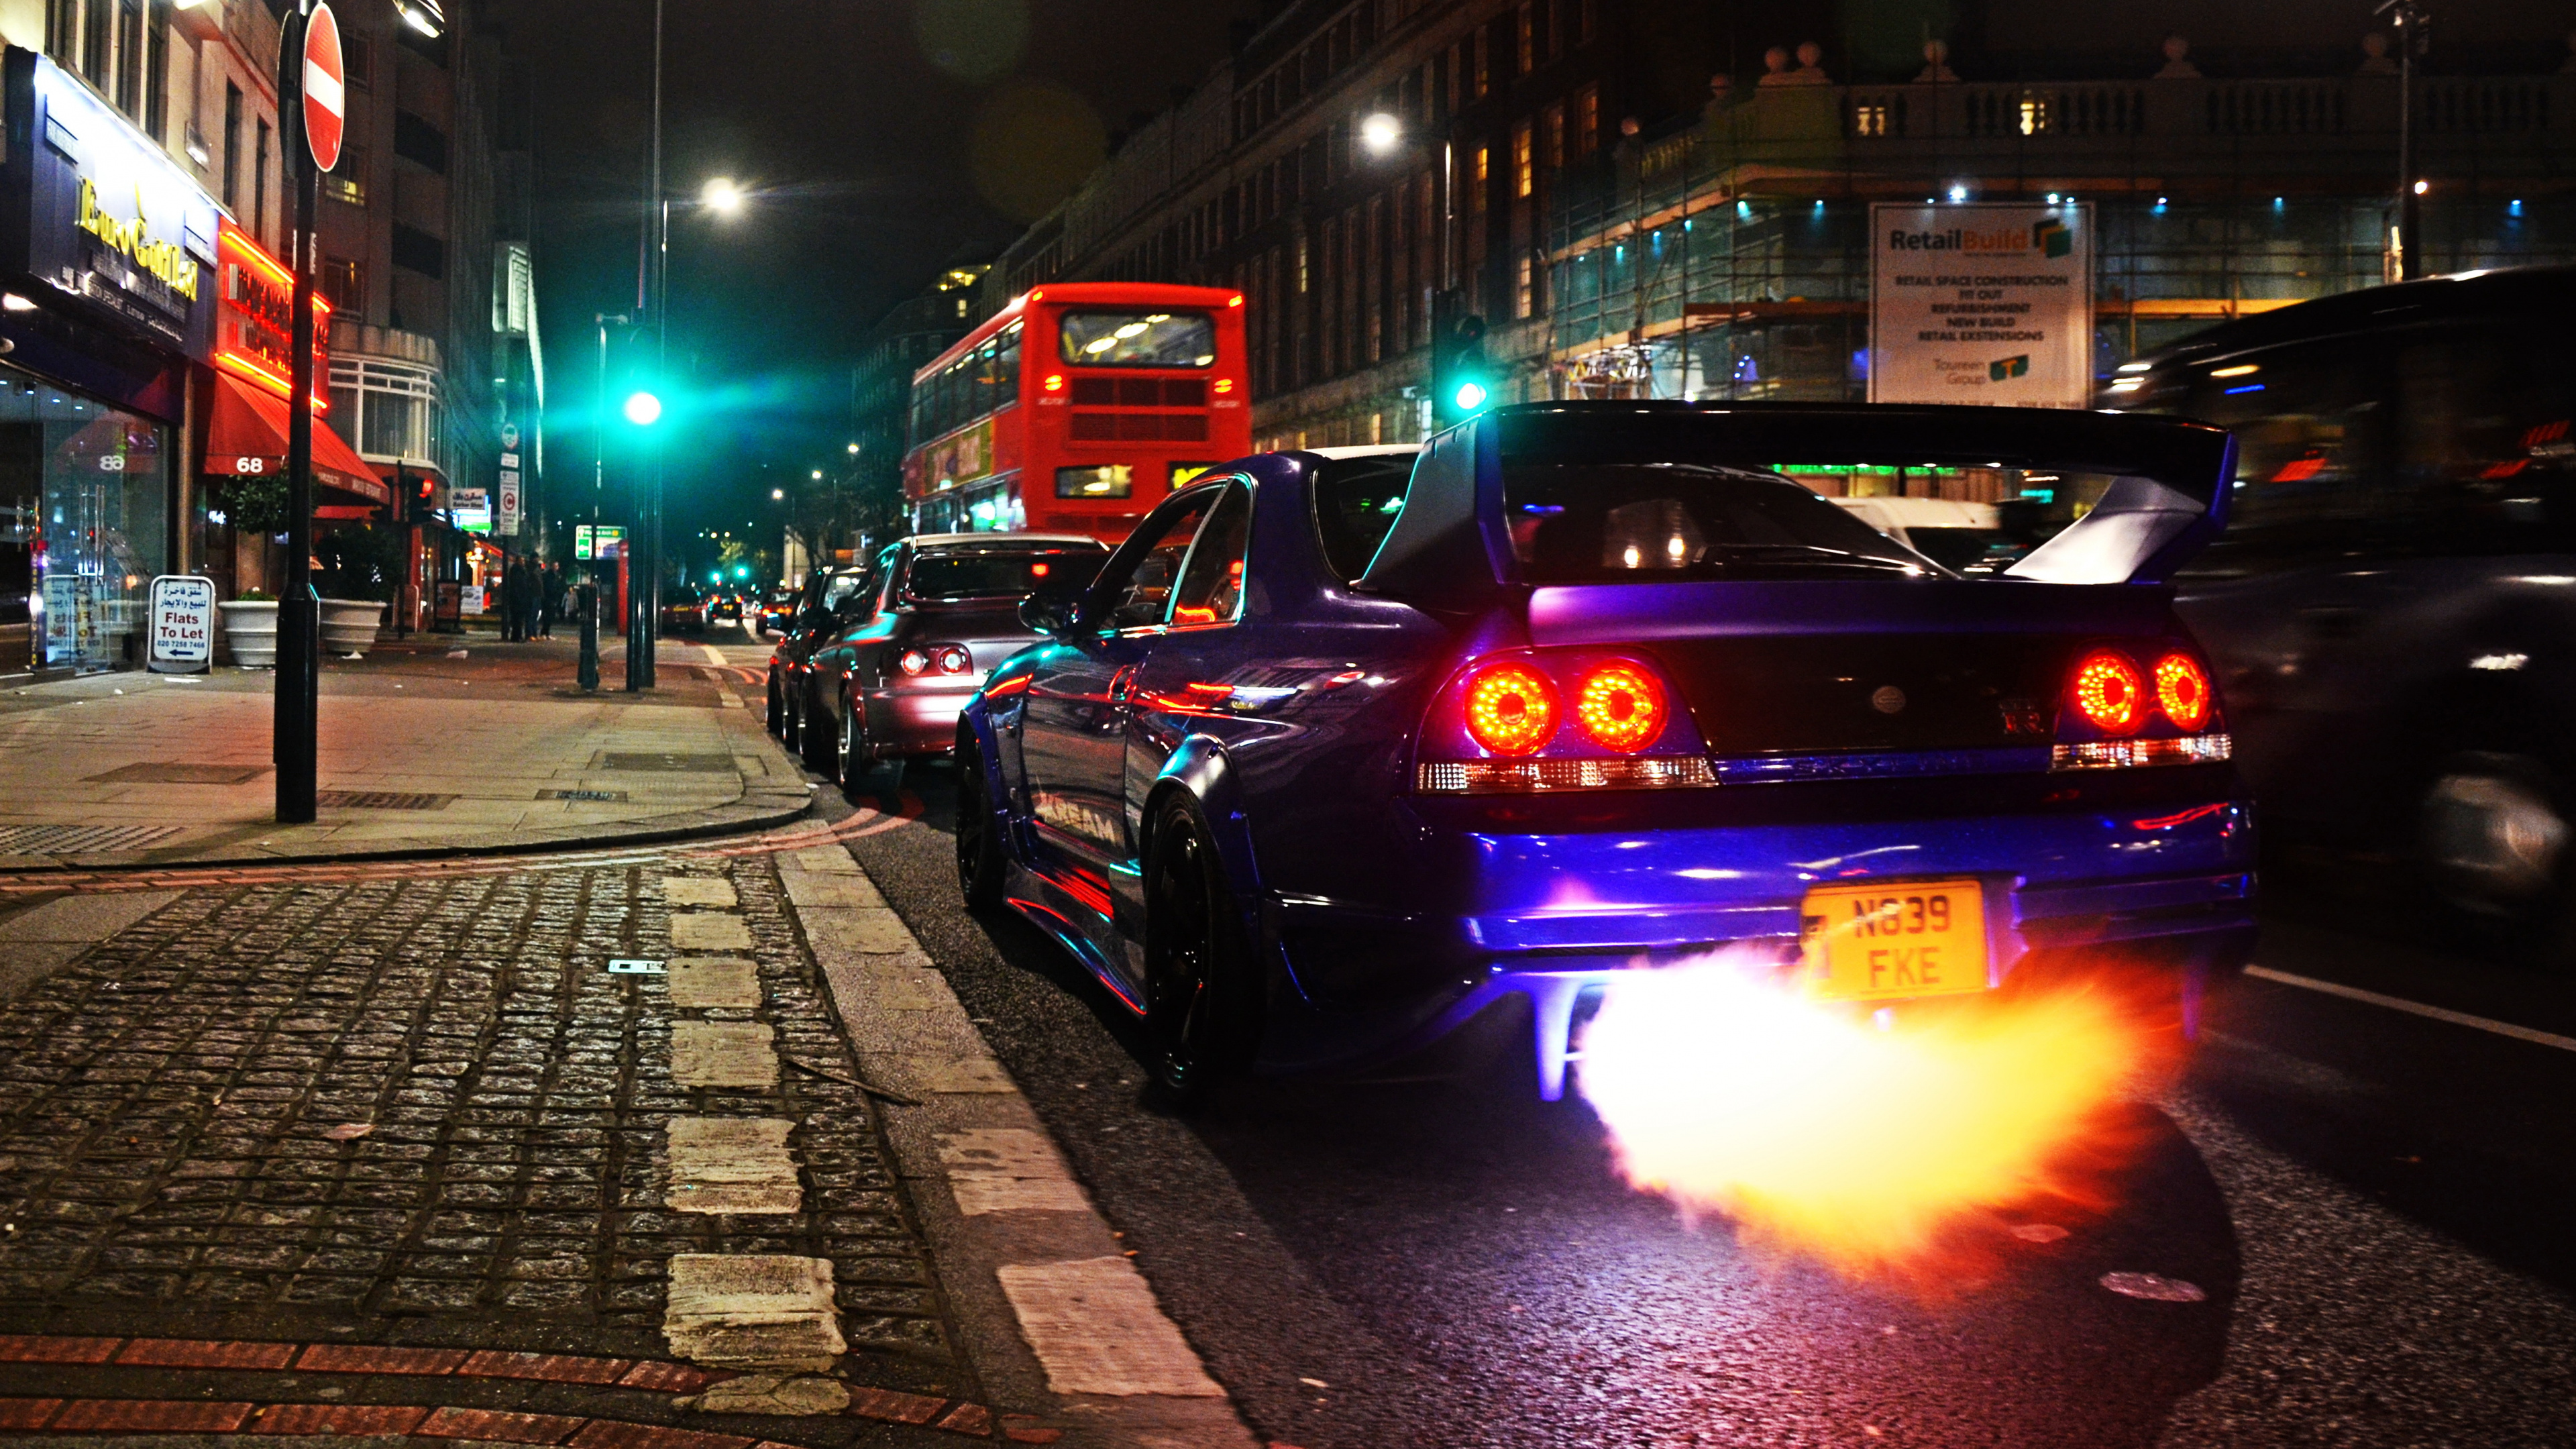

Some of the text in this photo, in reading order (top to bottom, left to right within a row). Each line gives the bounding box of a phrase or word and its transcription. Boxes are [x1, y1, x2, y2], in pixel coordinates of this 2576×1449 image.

[1890, 229, 2029, 251] RetailBuild
[1896, 275, 2069, 286] RETAIL SPACE CONSTRUCTION
[1978, 289, 2002, 300] OUT
[1947, 317, 1976, 327] NEW
[1918, 331, 1956, 341] RETAIL
[237, 457, 263, 473] 68
[165, 612, 199, 624] Flats
[160, 627, 204, 639] To Let
[1852, 894, 1951, 938] N839
[1868, 945, 1941, 988] FKE
